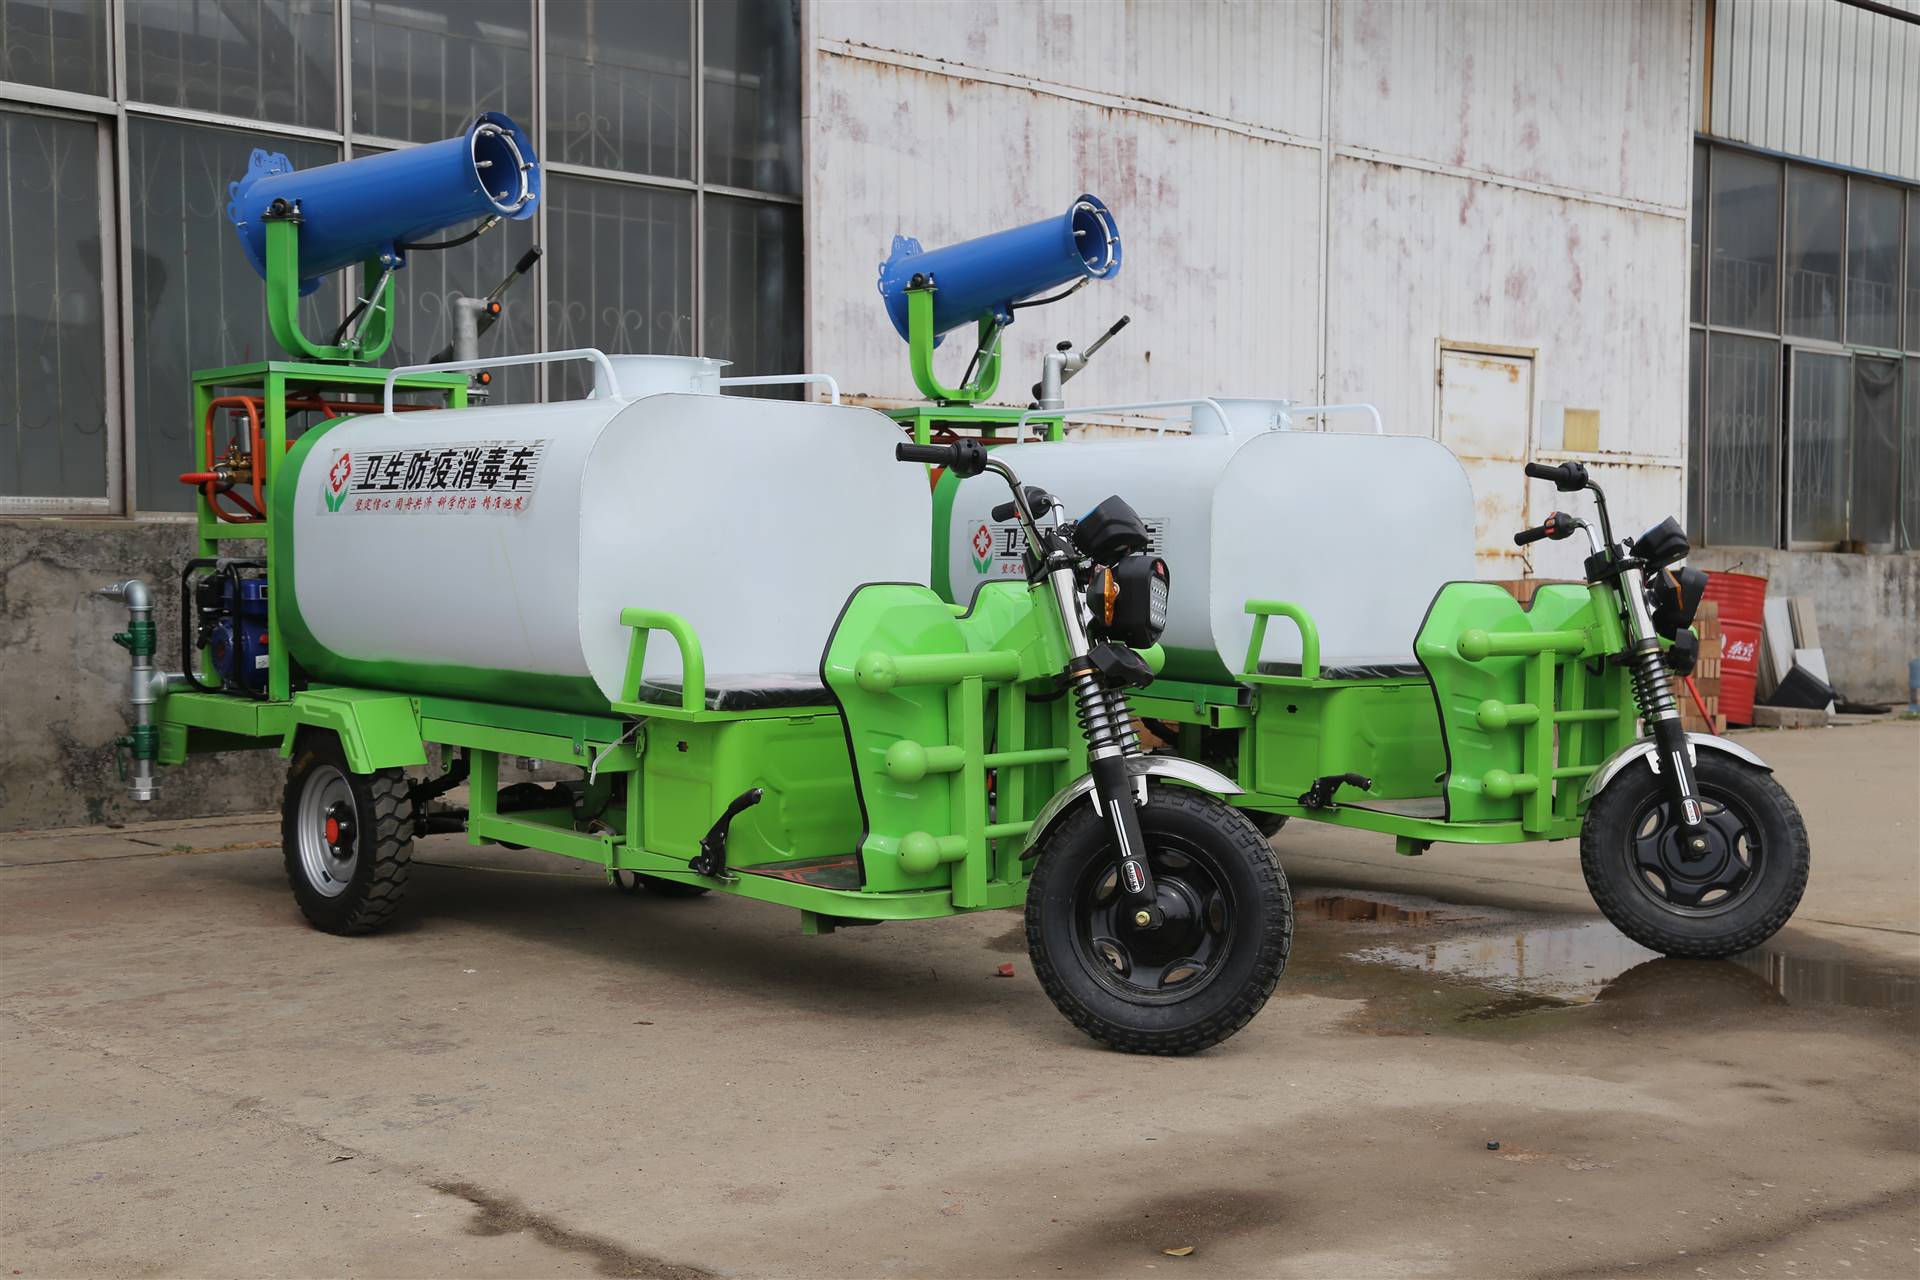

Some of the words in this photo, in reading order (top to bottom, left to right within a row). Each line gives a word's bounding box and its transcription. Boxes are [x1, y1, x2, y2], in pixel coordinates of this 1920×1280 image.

[356, 447, 535, 491] 卫生防疫消毒车
[437, 495, 477, 511] 科学防治
